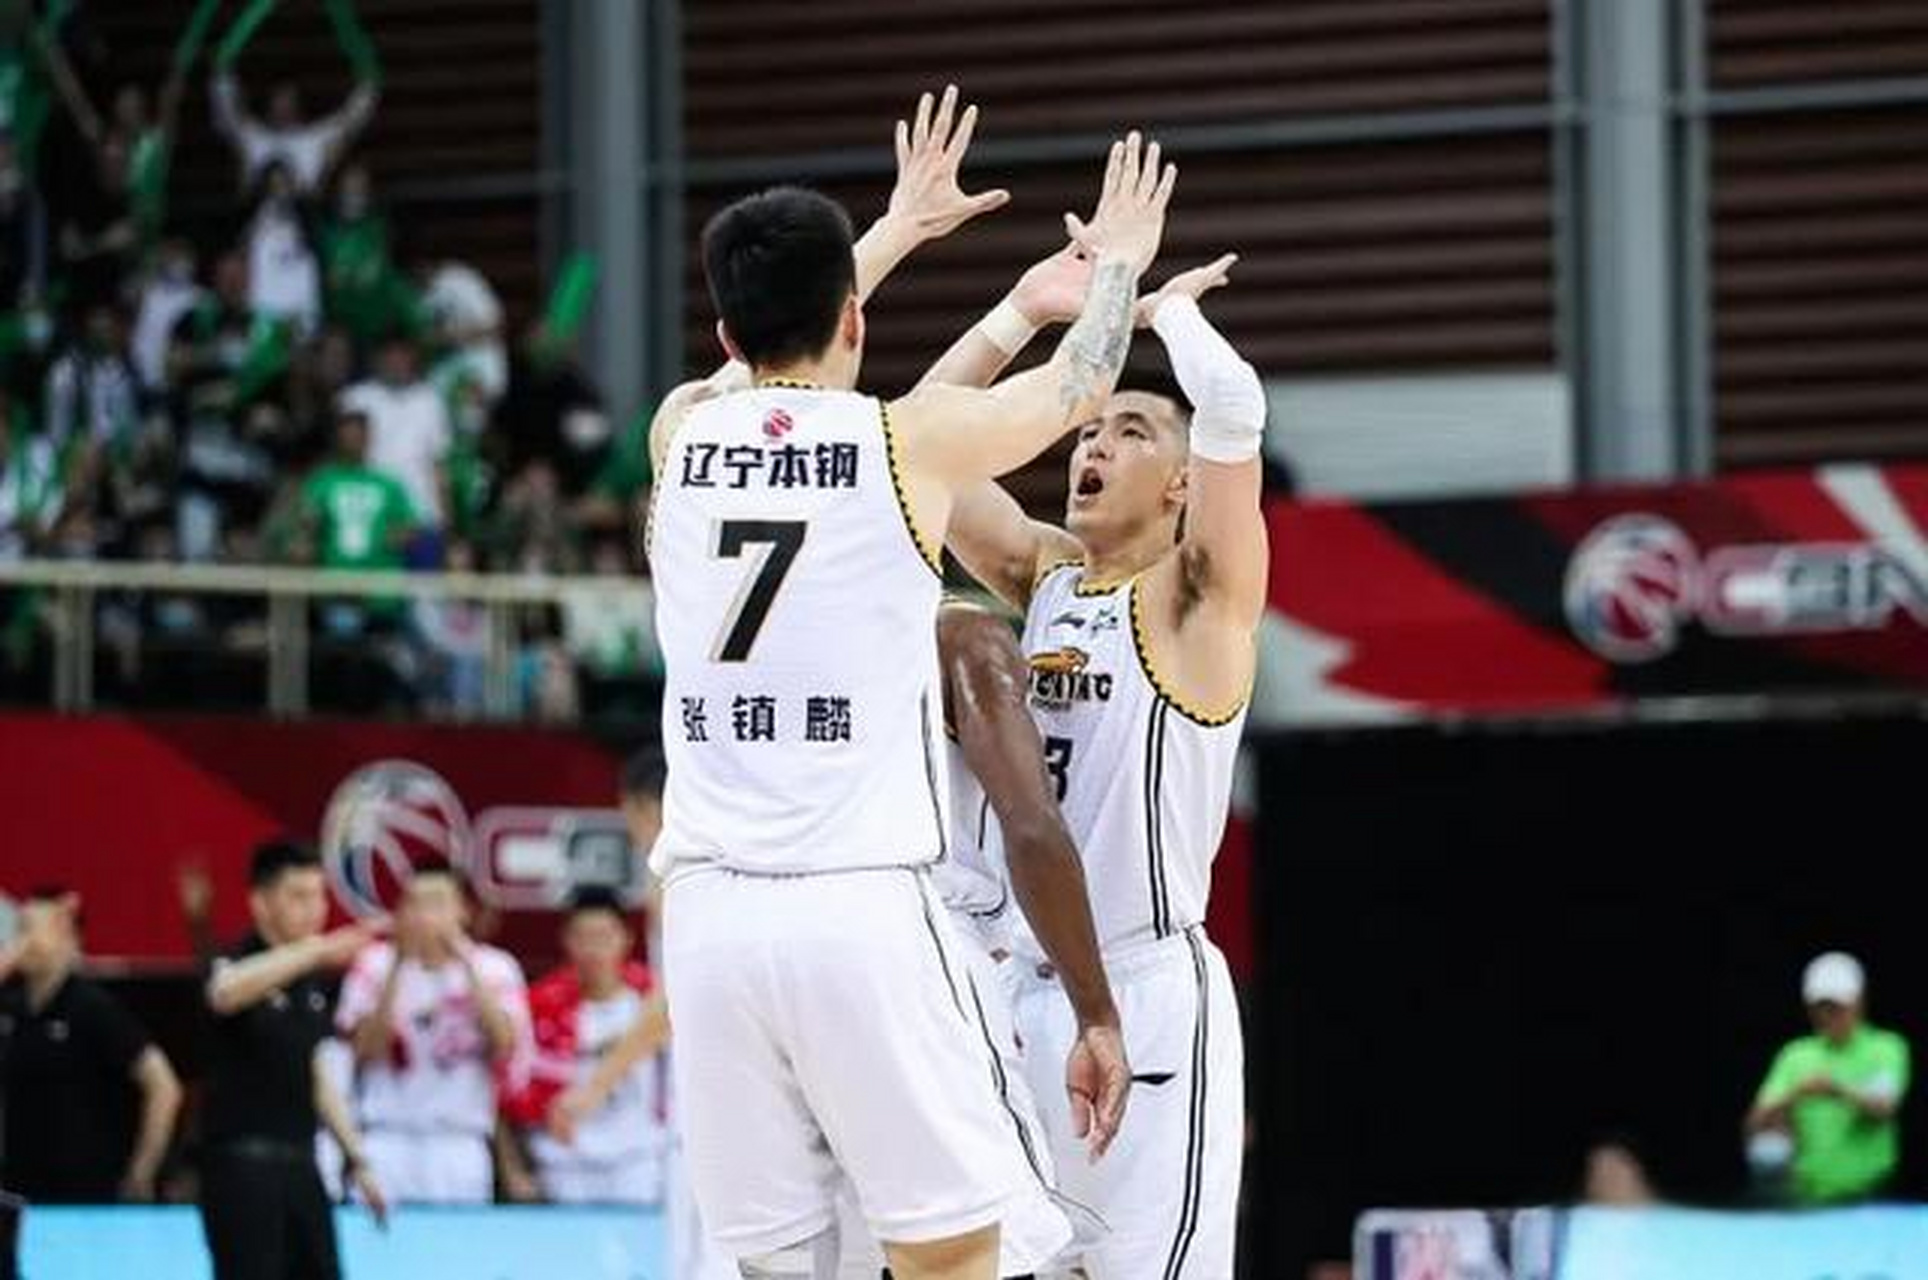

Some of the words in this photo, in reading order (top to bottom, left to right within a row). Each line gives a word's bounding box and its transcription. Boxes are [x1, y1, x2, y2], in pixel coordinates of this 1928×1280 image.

[680, 443, 859, 489] 辽宁本钢
[712, 520, 808, 663] 7
